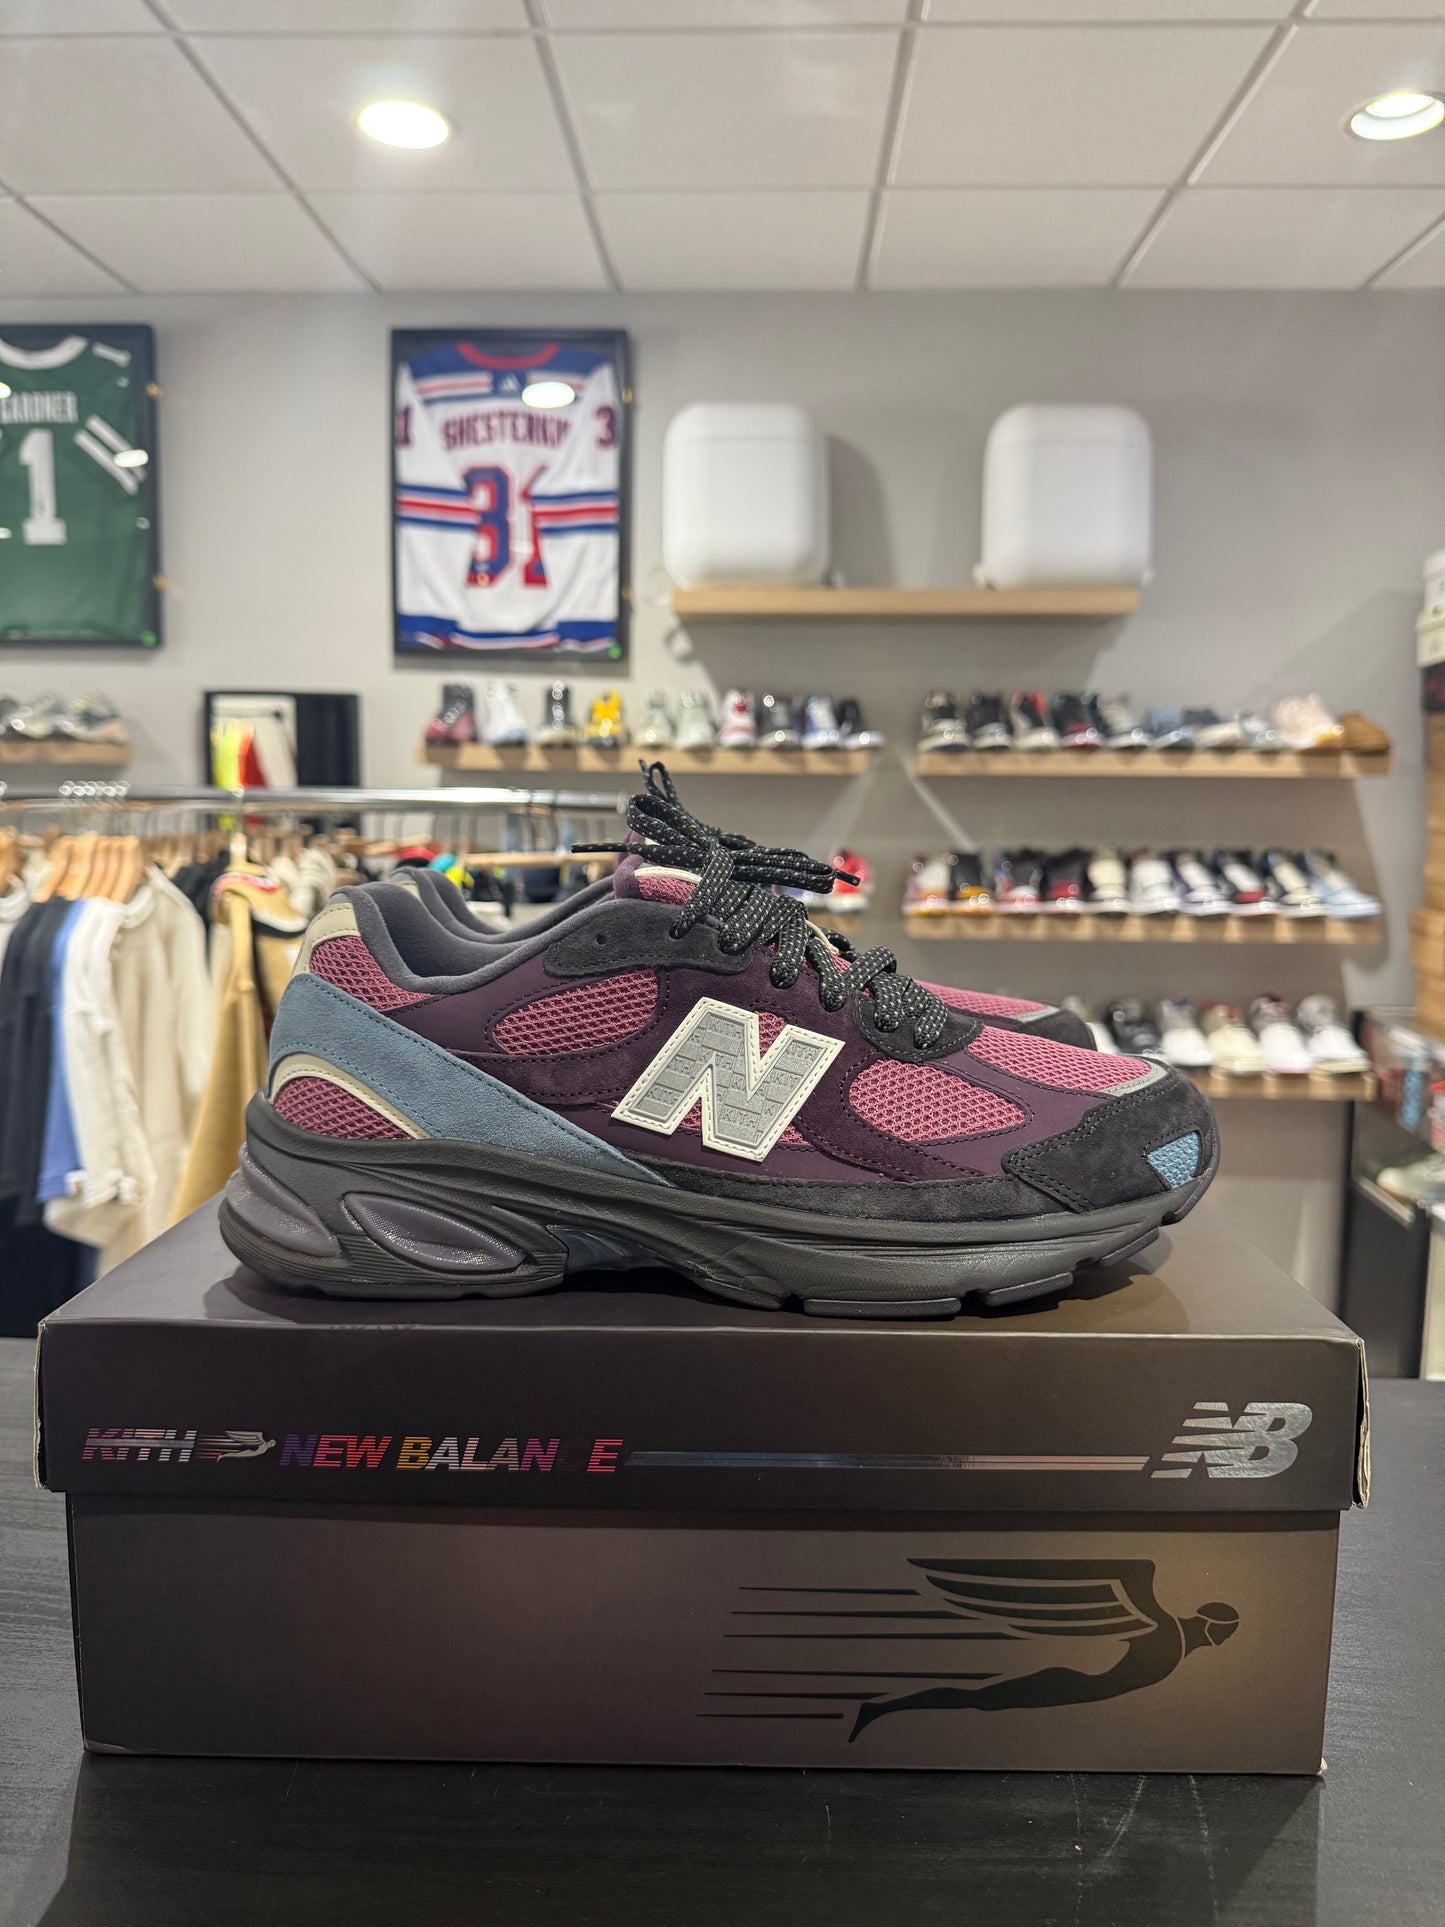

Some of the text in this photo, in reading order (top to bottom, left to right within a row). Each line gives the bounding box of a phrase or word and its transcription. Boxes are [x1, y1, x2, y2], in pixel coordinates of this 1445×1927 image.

[19, 428, 67, 546] 1
[611, 996, 845, 1162] N
[279, 1434, 393, 1468] NEW
[397, 1436, 624, 1473] BALANE
